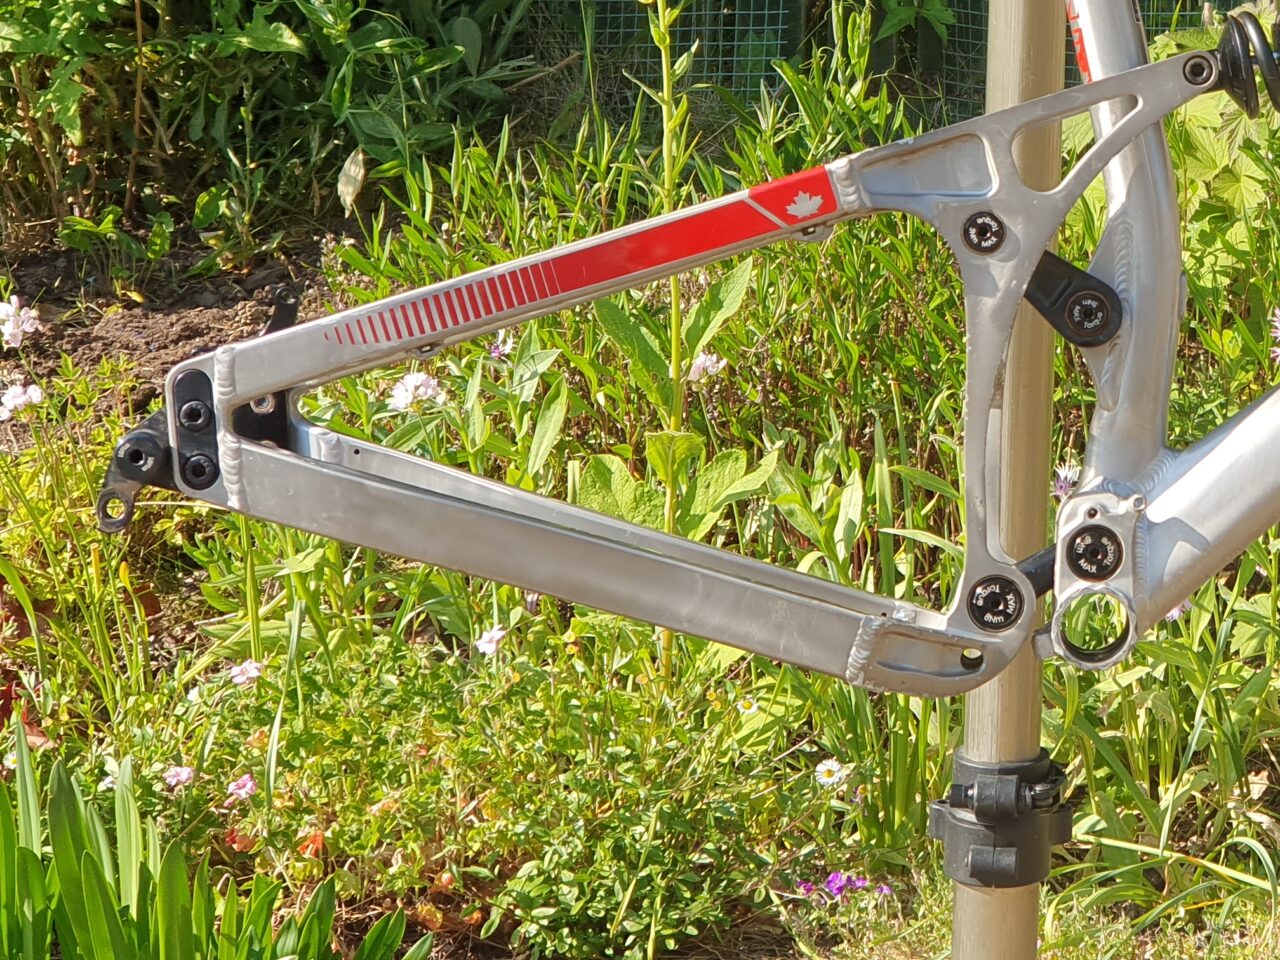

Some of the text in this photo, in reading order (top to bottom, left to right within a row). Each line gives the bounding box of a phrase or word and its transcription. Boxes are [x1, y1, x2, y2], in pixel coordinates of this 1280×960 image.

[976, 216, 999, 232] Torque
[981, 236, 998, 248] MAX
[1072, 305, 1081, 322] MAX
[1083, 311, 1103, 329] Torque
[1078, 558, 1097, 574] MAX
[1101, 536, 1115, 566] Torque
[976, 584, 1000, 607] Torque
[1005, 592, 1016, 615] MAX
